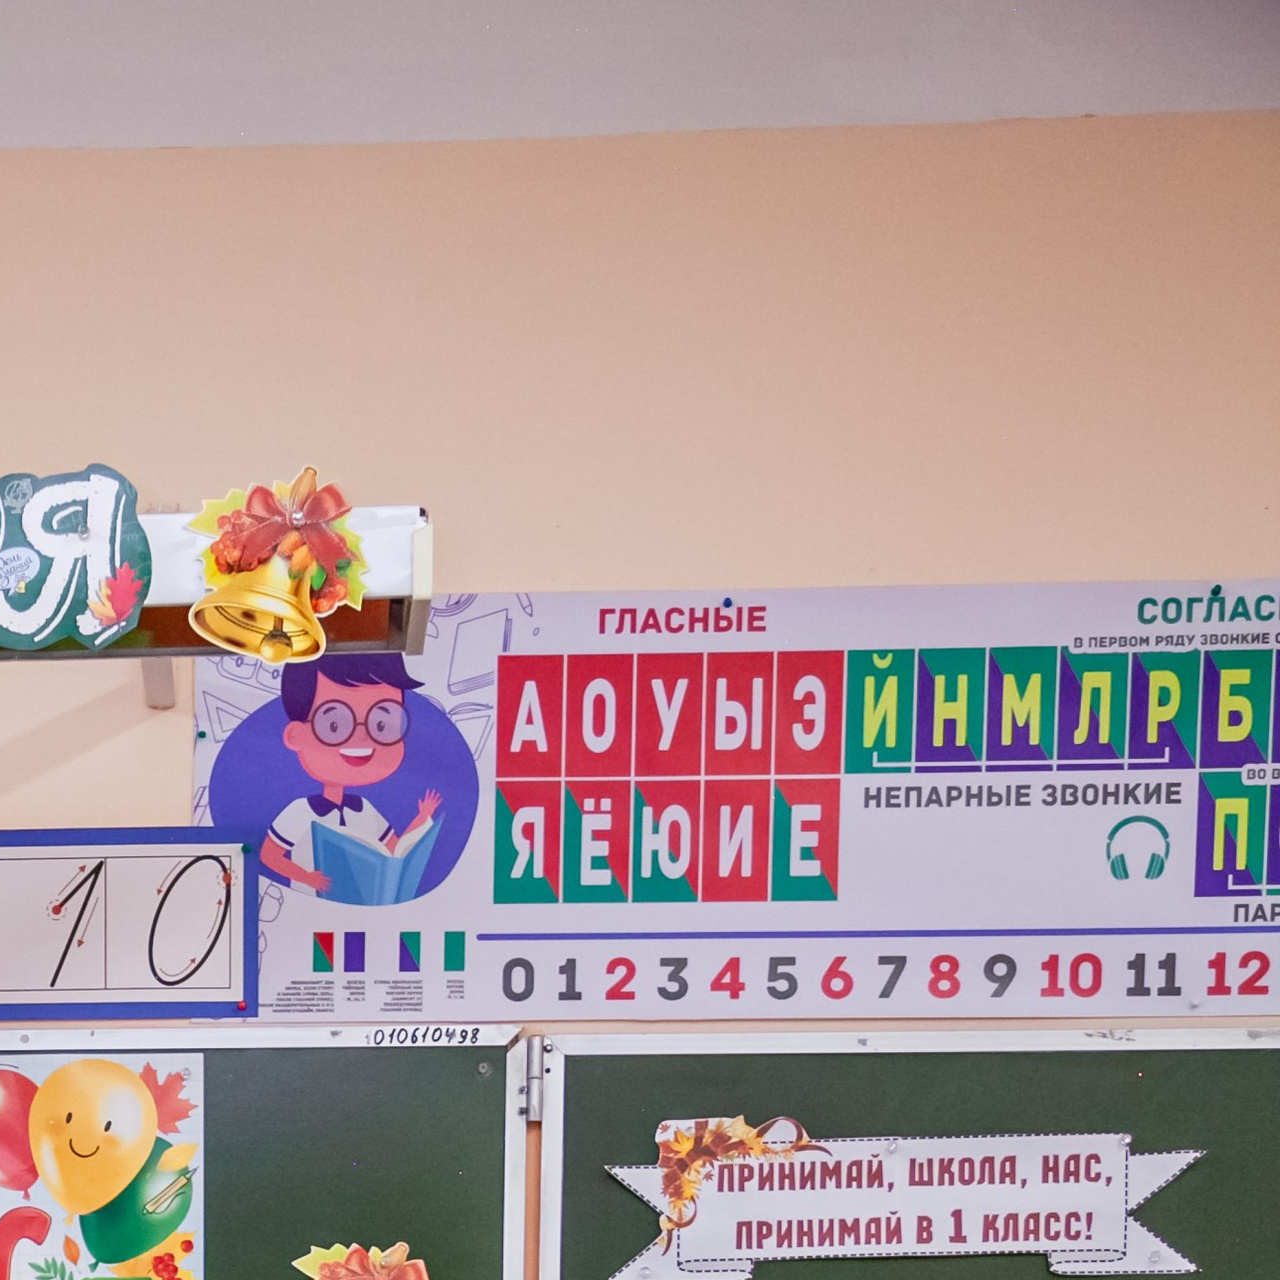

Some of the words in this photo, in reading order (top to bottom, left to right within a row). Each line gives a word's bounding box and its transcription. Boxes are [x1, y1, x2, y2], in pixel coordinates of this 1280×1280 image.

[599, 606, 766, 634] ГЛАСНЫЕ
[1138, 595, 1280, 624] СОГЛАС
[1088, 636, 1150, 648] ПЕРВОМ
[1156, 634, 1195, 646] РЯДУ
[1200, 633, 1271, 645] ЗВОНКИЕ
[863, 784, 1032, 809] НЕПАРНЫЕ
[1041, 782, 1182, 807] ЗВОНКИЕ
[502, 957, 535, 1001] 0
[558, 958, 583, 1001] 1
[605, 957, 637, 1001] 2
[657, 957, 689, 1001] 3
[710, 957, 746, 1000] 4
[766, 956, 798, 1000] 5
[821, 956, 854, 1000] 6
[877, 955, 908, 999] 7
[928, 954, 961, 999] 8
[983, 953, 1017, 998] 9
[1040, 953, 1103, 998] 10
[1126, 952, 1182, 997] 11
[1207, 951, 1271, 996] 12
[716, 1153, 894, 1193] ПРИНИМАЙ,
[908, 1155, 1028, 1190] ШКОЛА,
[1041, 1153, 1113, 1187] НАС,
[734, 1211, 903, 1250] ПРИНИМАЙ
[916, 1215, 934, 1244] В
[949, 1208, 968, 1244] 1
[981, 1211, 1094, 1243] КЛАСС!
